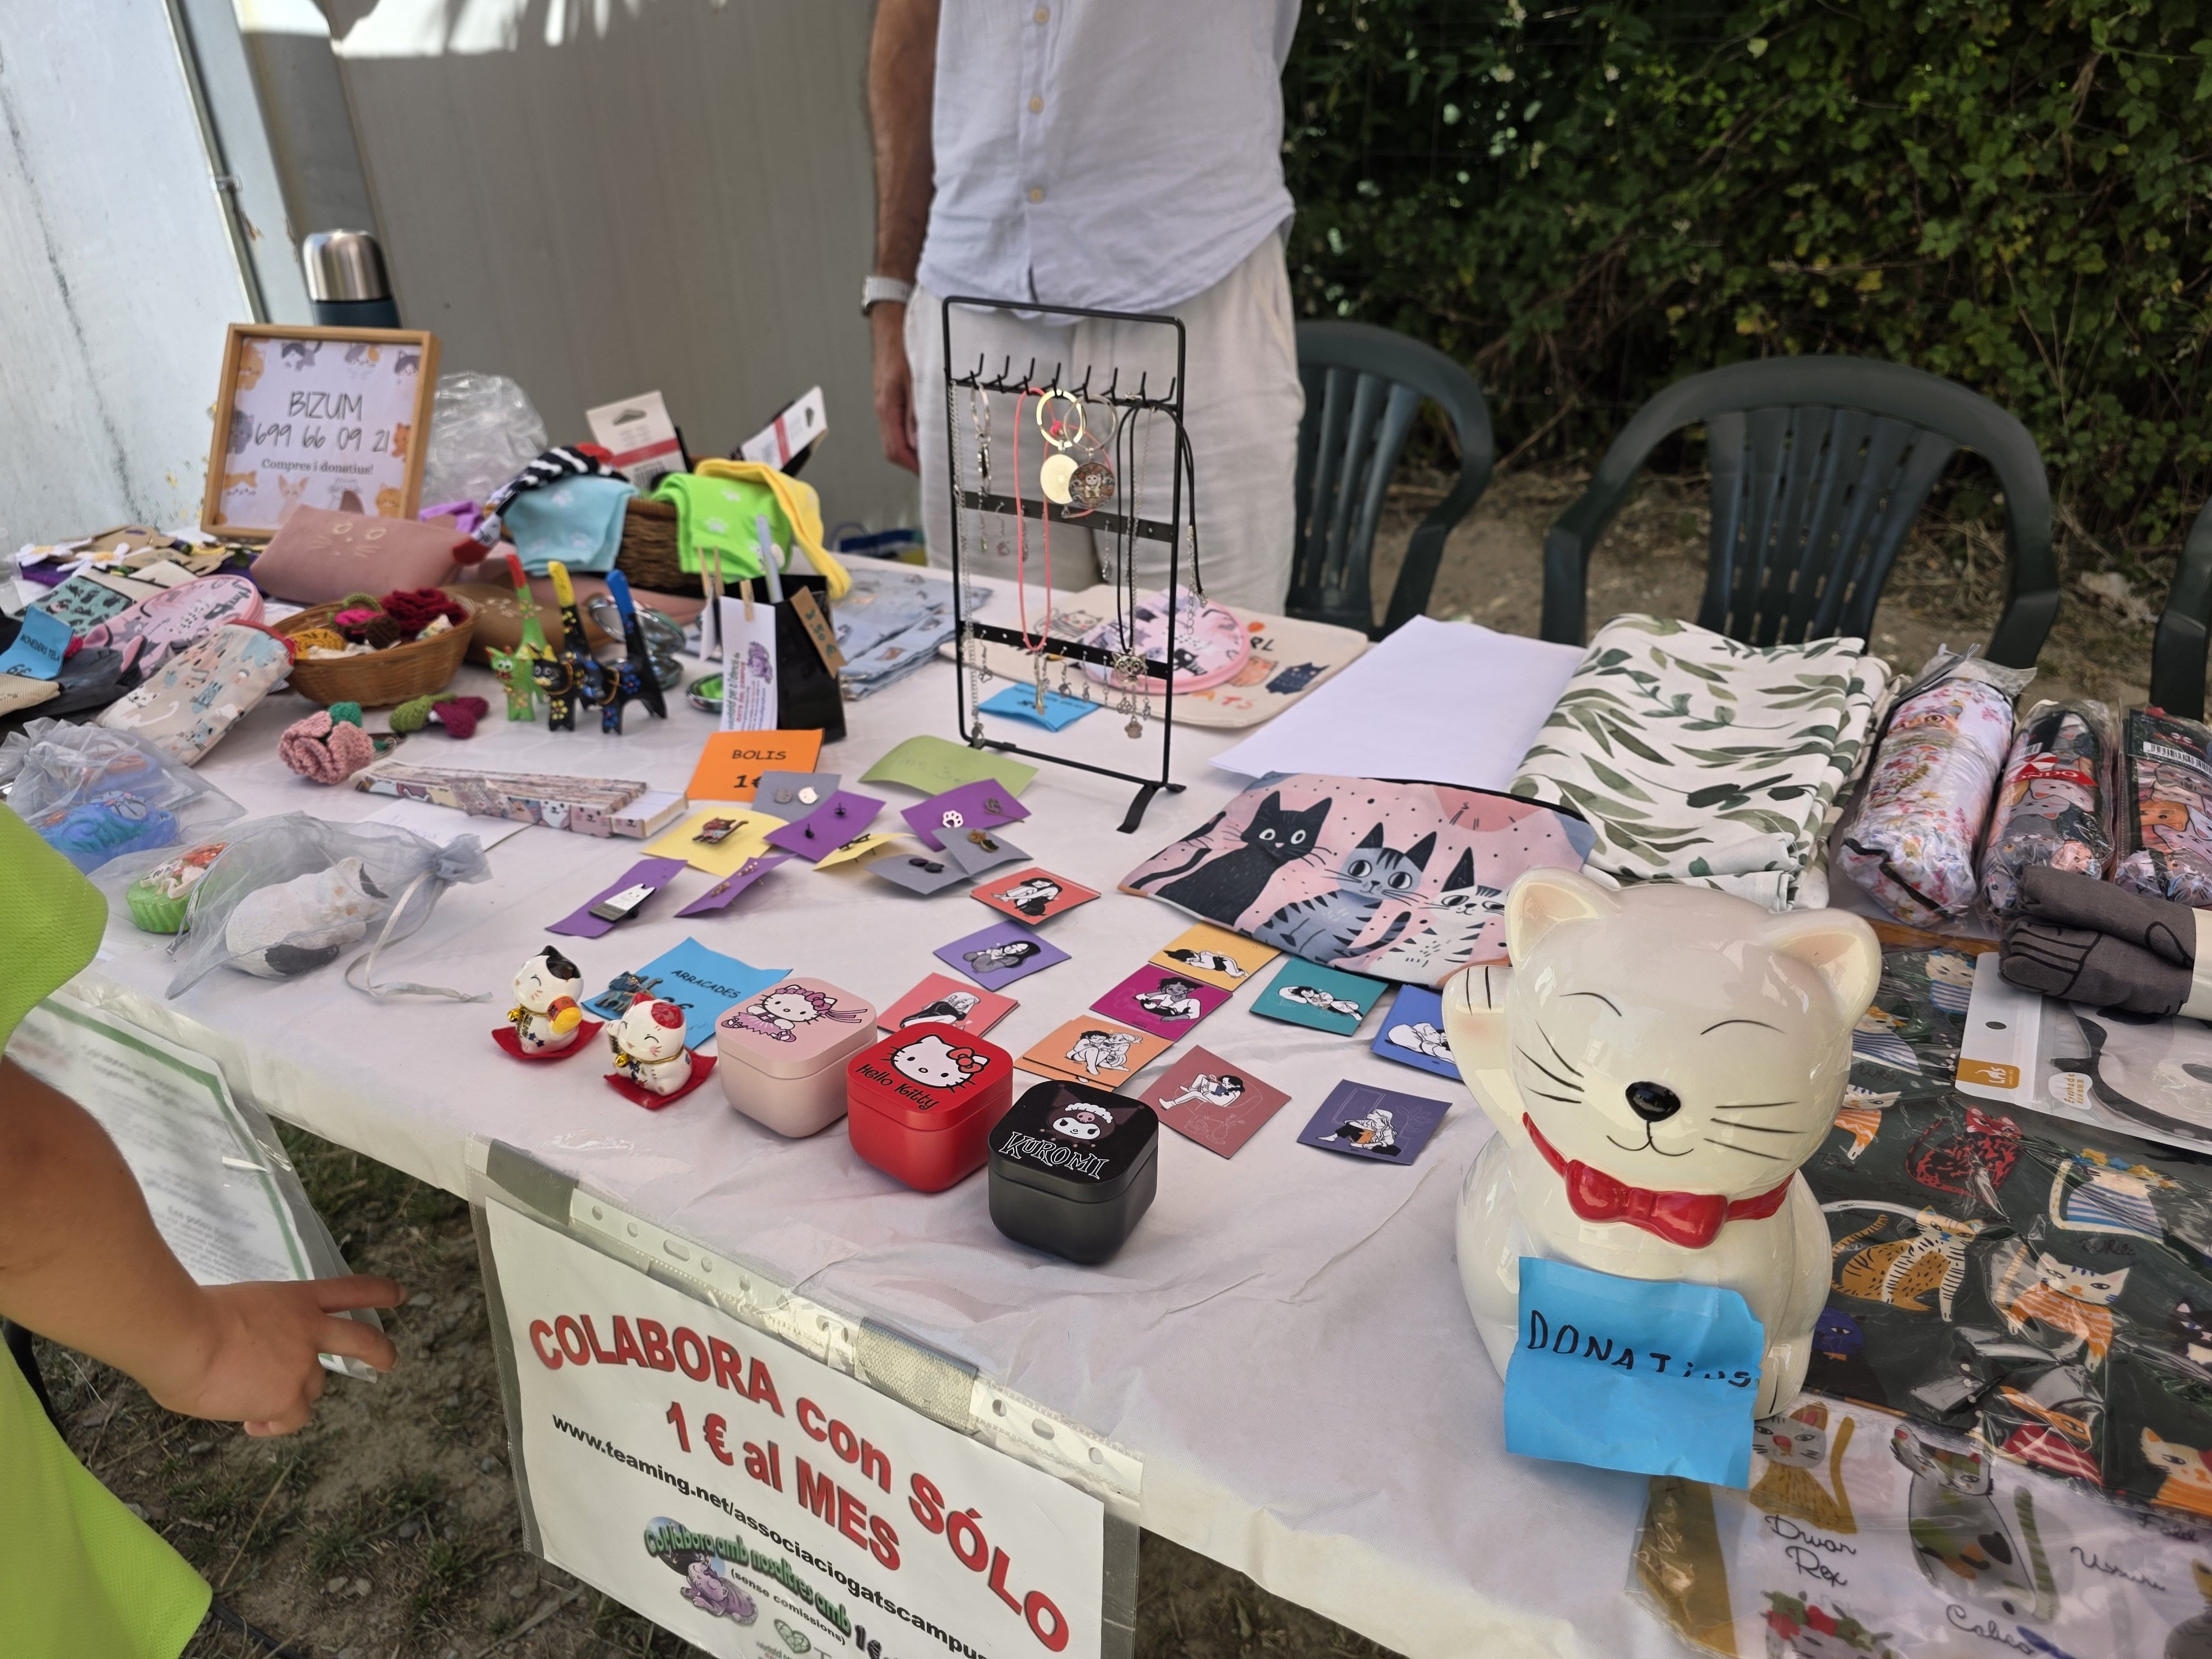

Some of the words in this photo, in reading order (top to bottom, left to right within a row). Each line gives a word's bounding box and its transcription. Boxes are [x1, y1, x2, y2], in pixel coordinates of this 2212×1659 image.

[289, 392, 362, 421] BIZUM
[254, 422, 291, 447] 699
[302, 425, 326, 448] 66
[338, 427, 362, 452] 09
[373, 429, 390, 452] 21
[261, 457, 311, 472] Compres
[313, 460, 319, 472] i
[320, 461, 374, 475] donatius!
[20, 634, 48, 655] MONEDERS
[49, 648, 60, 662] TELA
[732, 750, 787, 760] BOLIS
[671, 970, 741, 998] ARRACADES
[854, 1063, 894, 1087] Hello
[894, 1084, 940, 1110] Kitty
[2064, 1073, 2075, 1104] Eyeshade
[999, 1131, 1109, 1180] KUROMI
[530, 1314, 785, 1417] COLABORA
[796, 1397, 891, 1494] con
[909, 1473, 1069, 1652] SÓLO
[666, 1401, 691, 1453] 1
[703, 1413, 734, 1466] €
[743, 1440, 783, 1492] al
[796, 1455, 900, 1571] MES
[716, 1535, 749, 1567] amb
[750, 1556, 813, 1604] nosaltres
[815, 1592, 851, 1637] amb
[1785, 1546, 1848, 1587] Rex
[731, 1568, 770, 1597] (sense
[773, 1595, 846, 1645] comissions)
[1946, 1604, 2034, 1655] Calico
